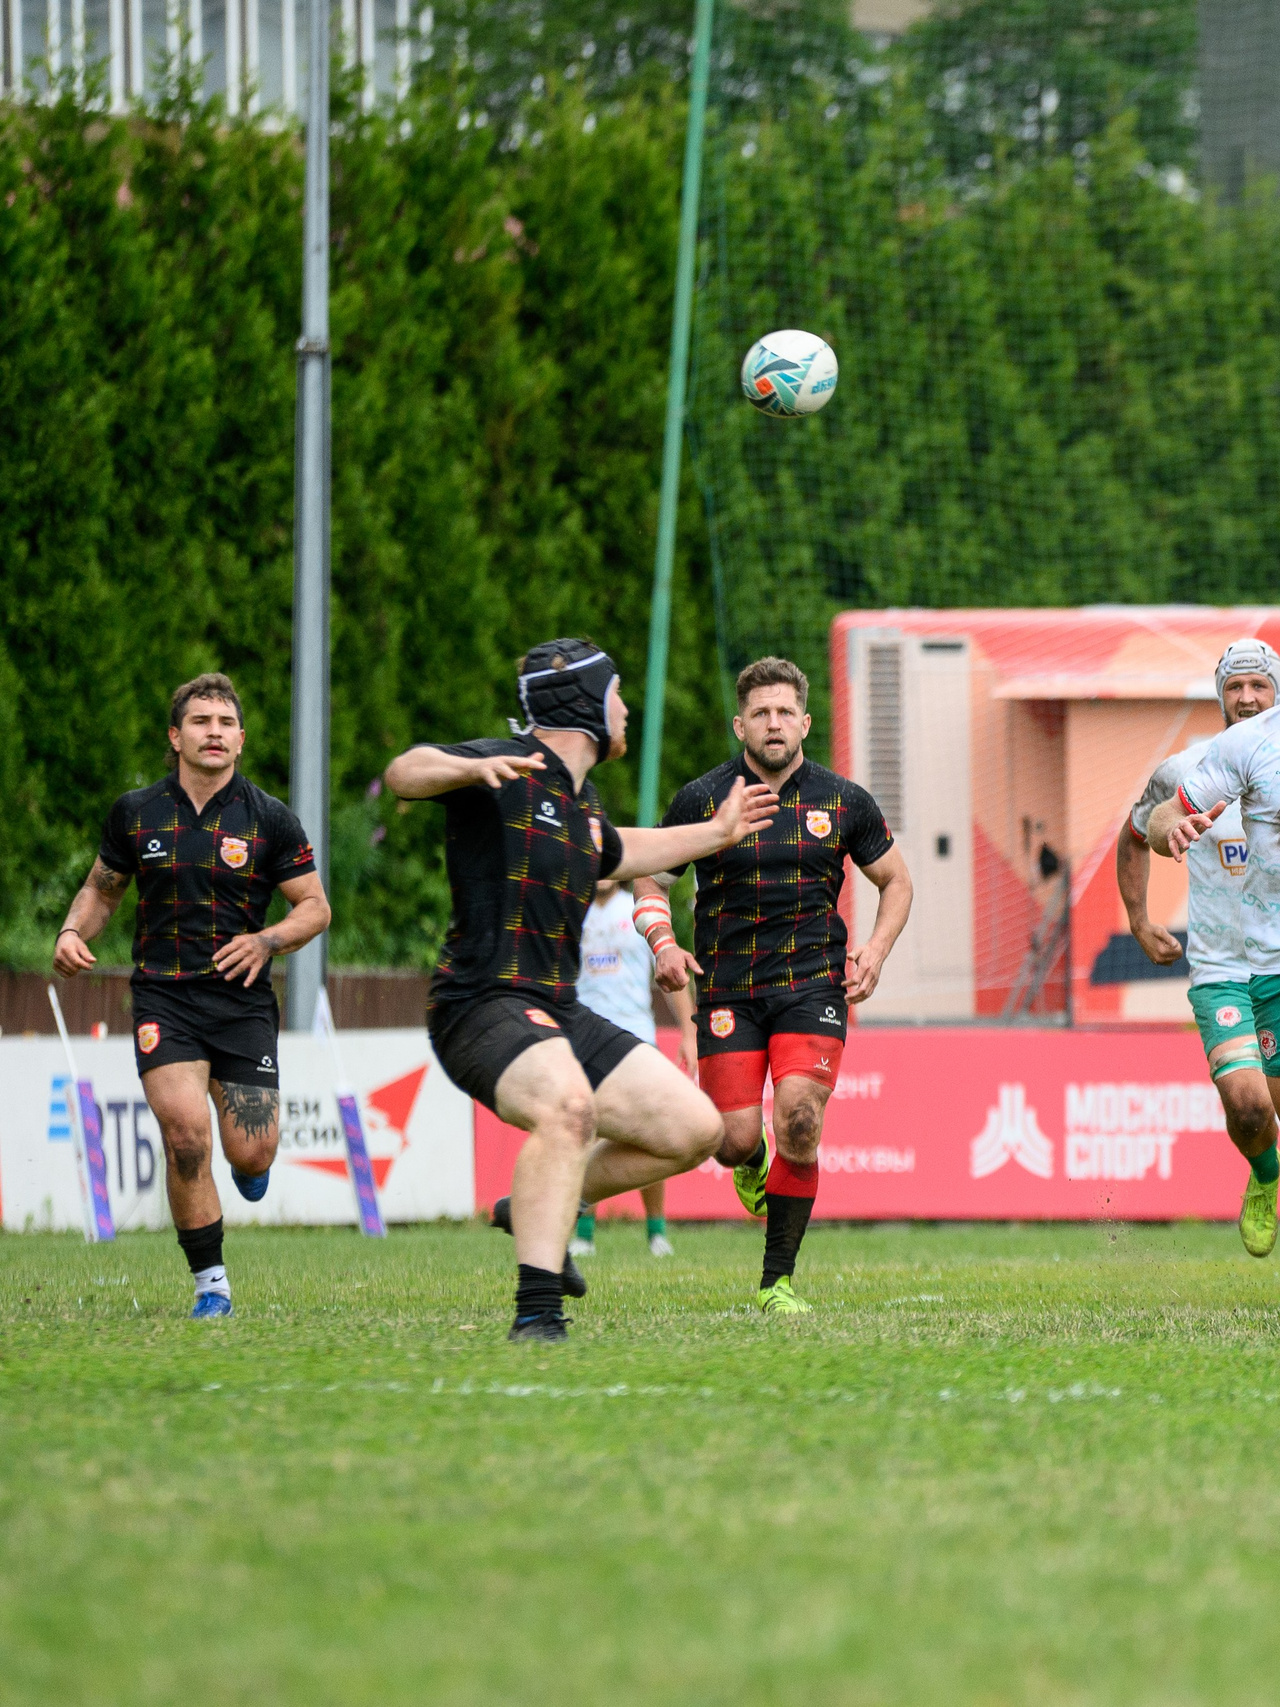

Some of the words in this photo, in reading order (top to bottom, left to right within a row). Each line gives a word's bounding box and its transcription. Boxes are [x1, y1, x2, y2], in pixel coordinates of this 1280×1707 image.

[1224, 845, 1248, 863] РИ
[1066, 1084, 1227, 1132] МОСКОВС
[94, 1101, 155, 1194] ТБ
[817, 1146, 916, 1173] осквы
[1066, 1134, 1177, 1180] СПОРТ
